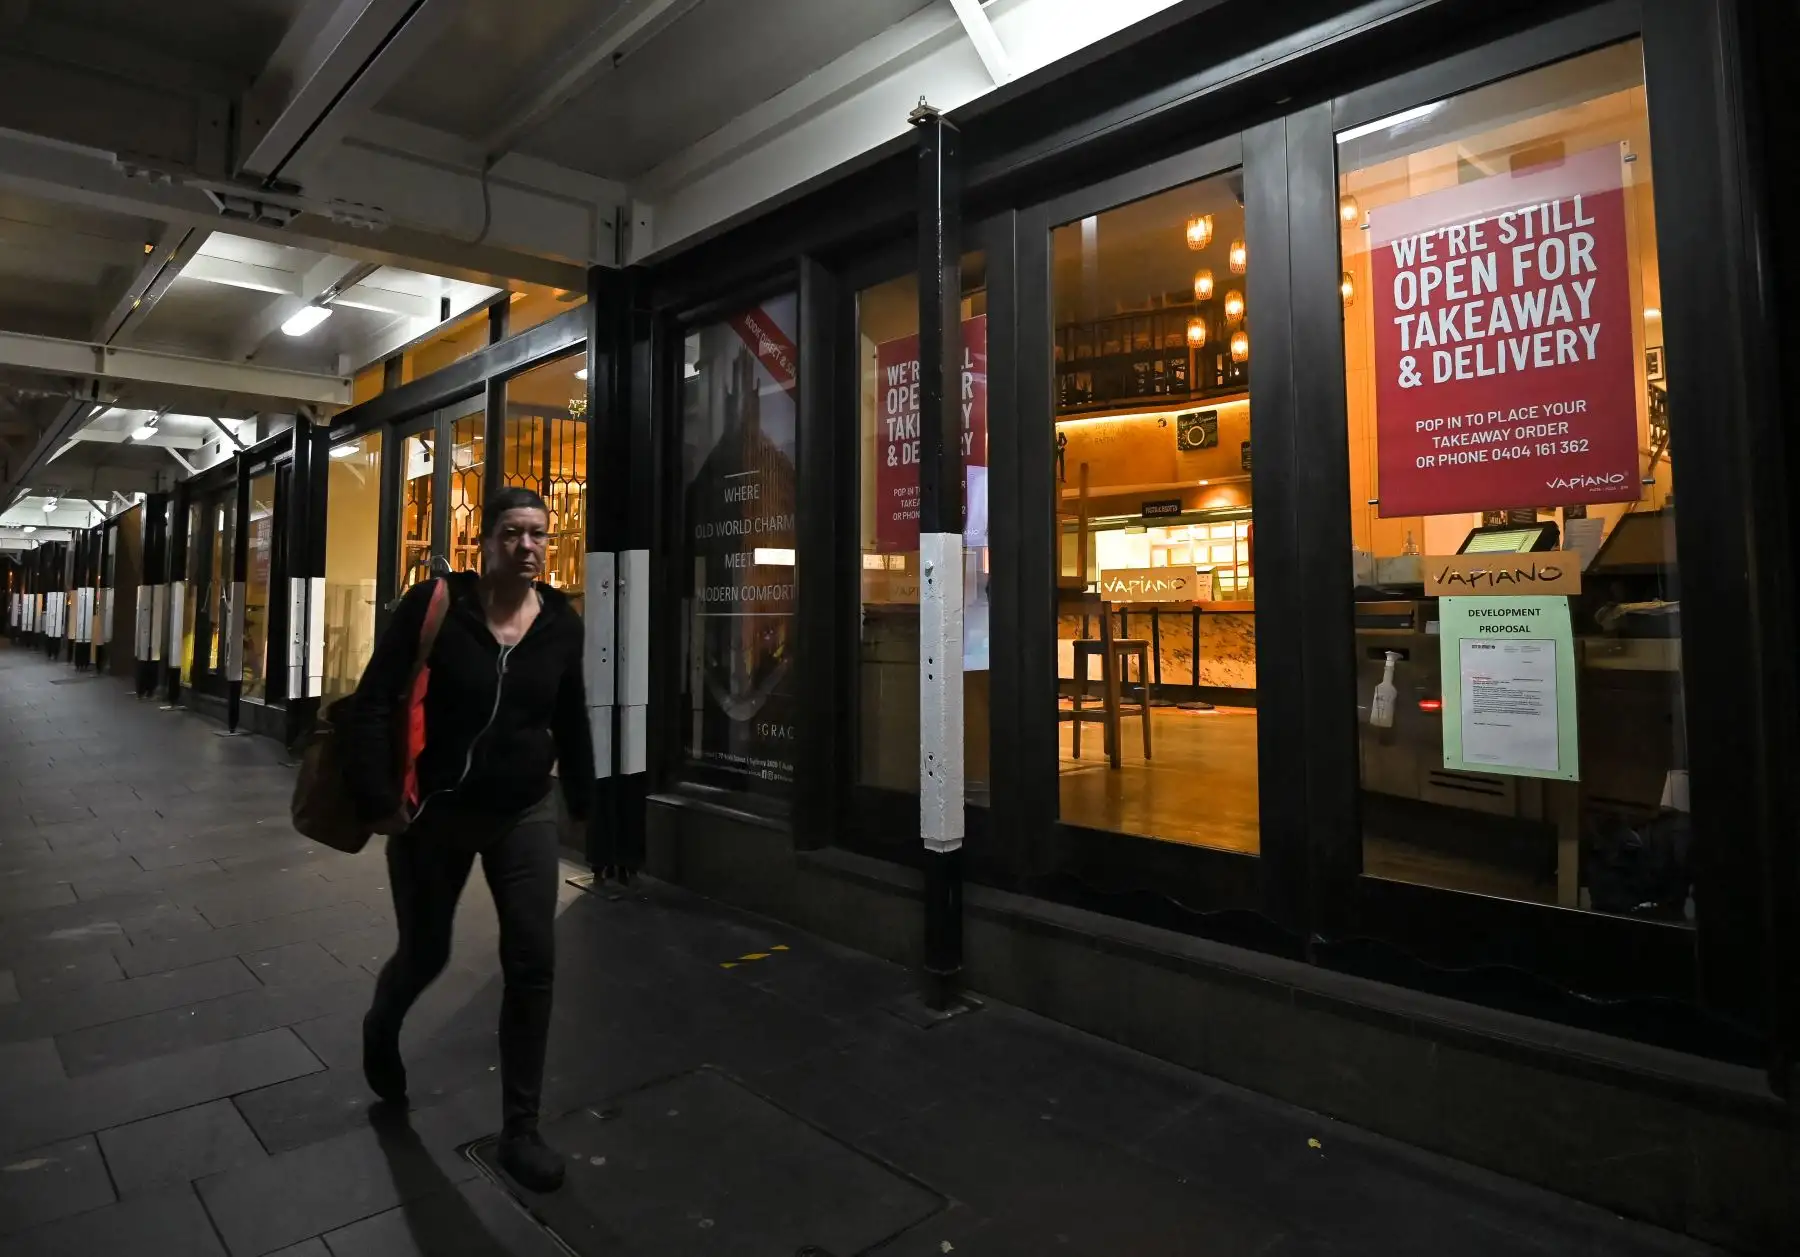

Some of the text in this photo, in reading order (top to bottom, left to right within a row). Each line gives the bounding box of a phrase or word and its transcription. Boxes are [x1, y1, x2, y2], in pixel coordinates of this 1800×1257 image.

[1391, 194, 1595, 268] WE'RE STILL
[1394, 232, 1597, 310] OPEN FOR
[1394, 278, 1596, 351] TAKEAWAY
[1398, 322, 1601, 388] & DELIVERY
[887, 360, 920, 387] WE'R
[887, 383, 920, 415] OPE
[1416, 399, 1587, 432] POP IN TO PLACE YOUR
[1432, 421, 1569, 449] TAKEAWAY ORDER
[1416, 438, 1589, 469] OR PHONE 0404 161 362
[724, 484, 760, 503] WHERE
[695, 514, 795, 539] OLD WORLD CHARM
[902, 511, 920, 520] PHON
[741, 584, 795, 602] COMFORT
[1468, 608, 1541, 618] DEVELOPMENT
[1479, 624, 1531, 634] PROPOSAL
